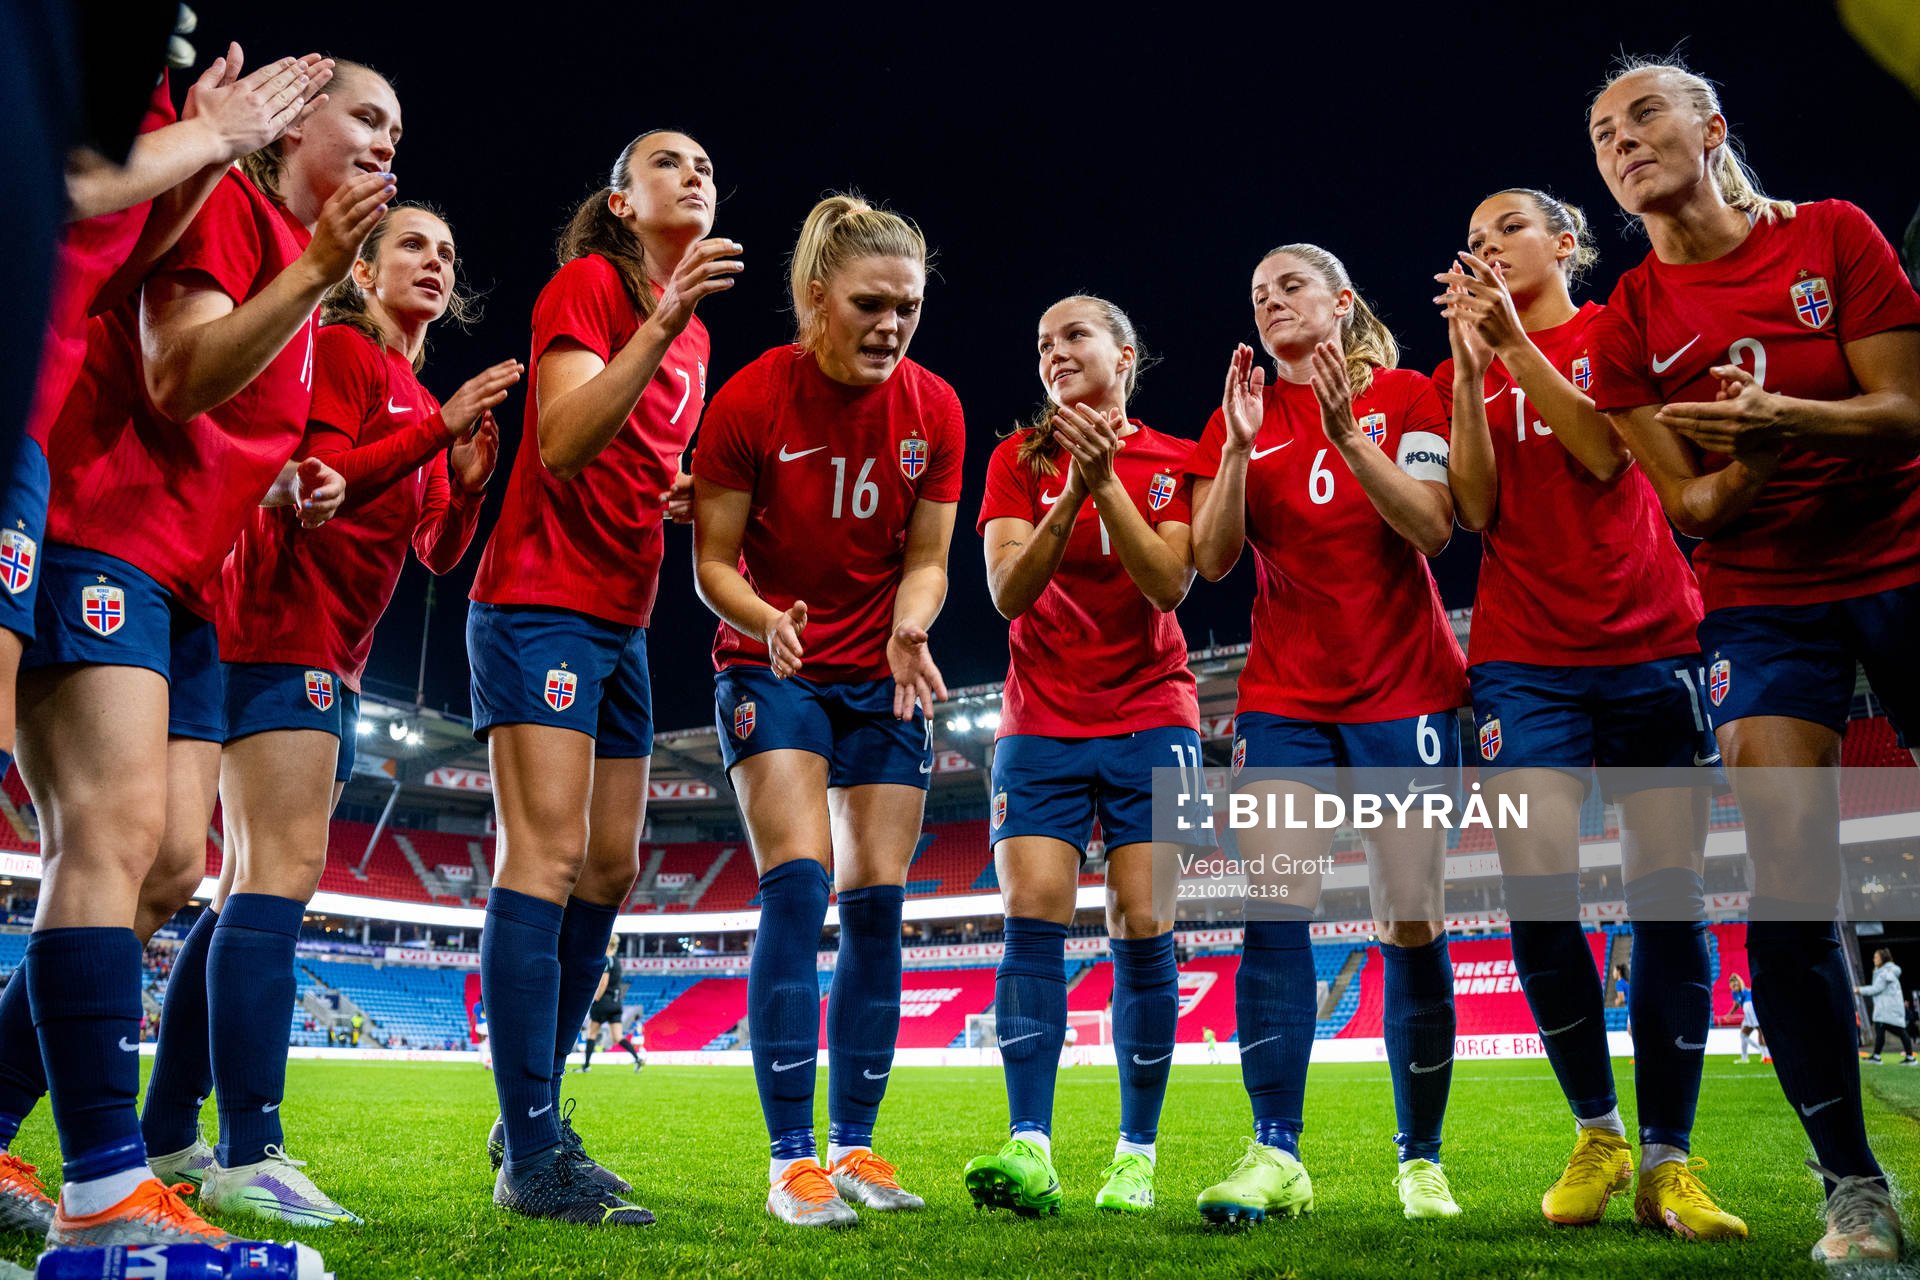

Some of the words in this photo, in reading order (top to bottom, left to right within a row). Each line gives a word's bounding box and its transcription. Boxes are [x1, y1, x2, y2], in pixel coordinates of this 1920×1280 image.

[674, 368, 691, 424] 7
[831, 457, 879, 519] 16
[1309, 448, 1335, 504] 6
[1416, 715, 1441, 765] 6
[436, 768, 491, 792] VG
[648, 782, 713, 800] VG
[1171, 745, 1200, 803] 11
[909, 947, 940, 959] VG
[946, 944, 979, 956] VG
[1065, 935, 1100, 950] VG
[1193, 929, 1231, 943] VG
